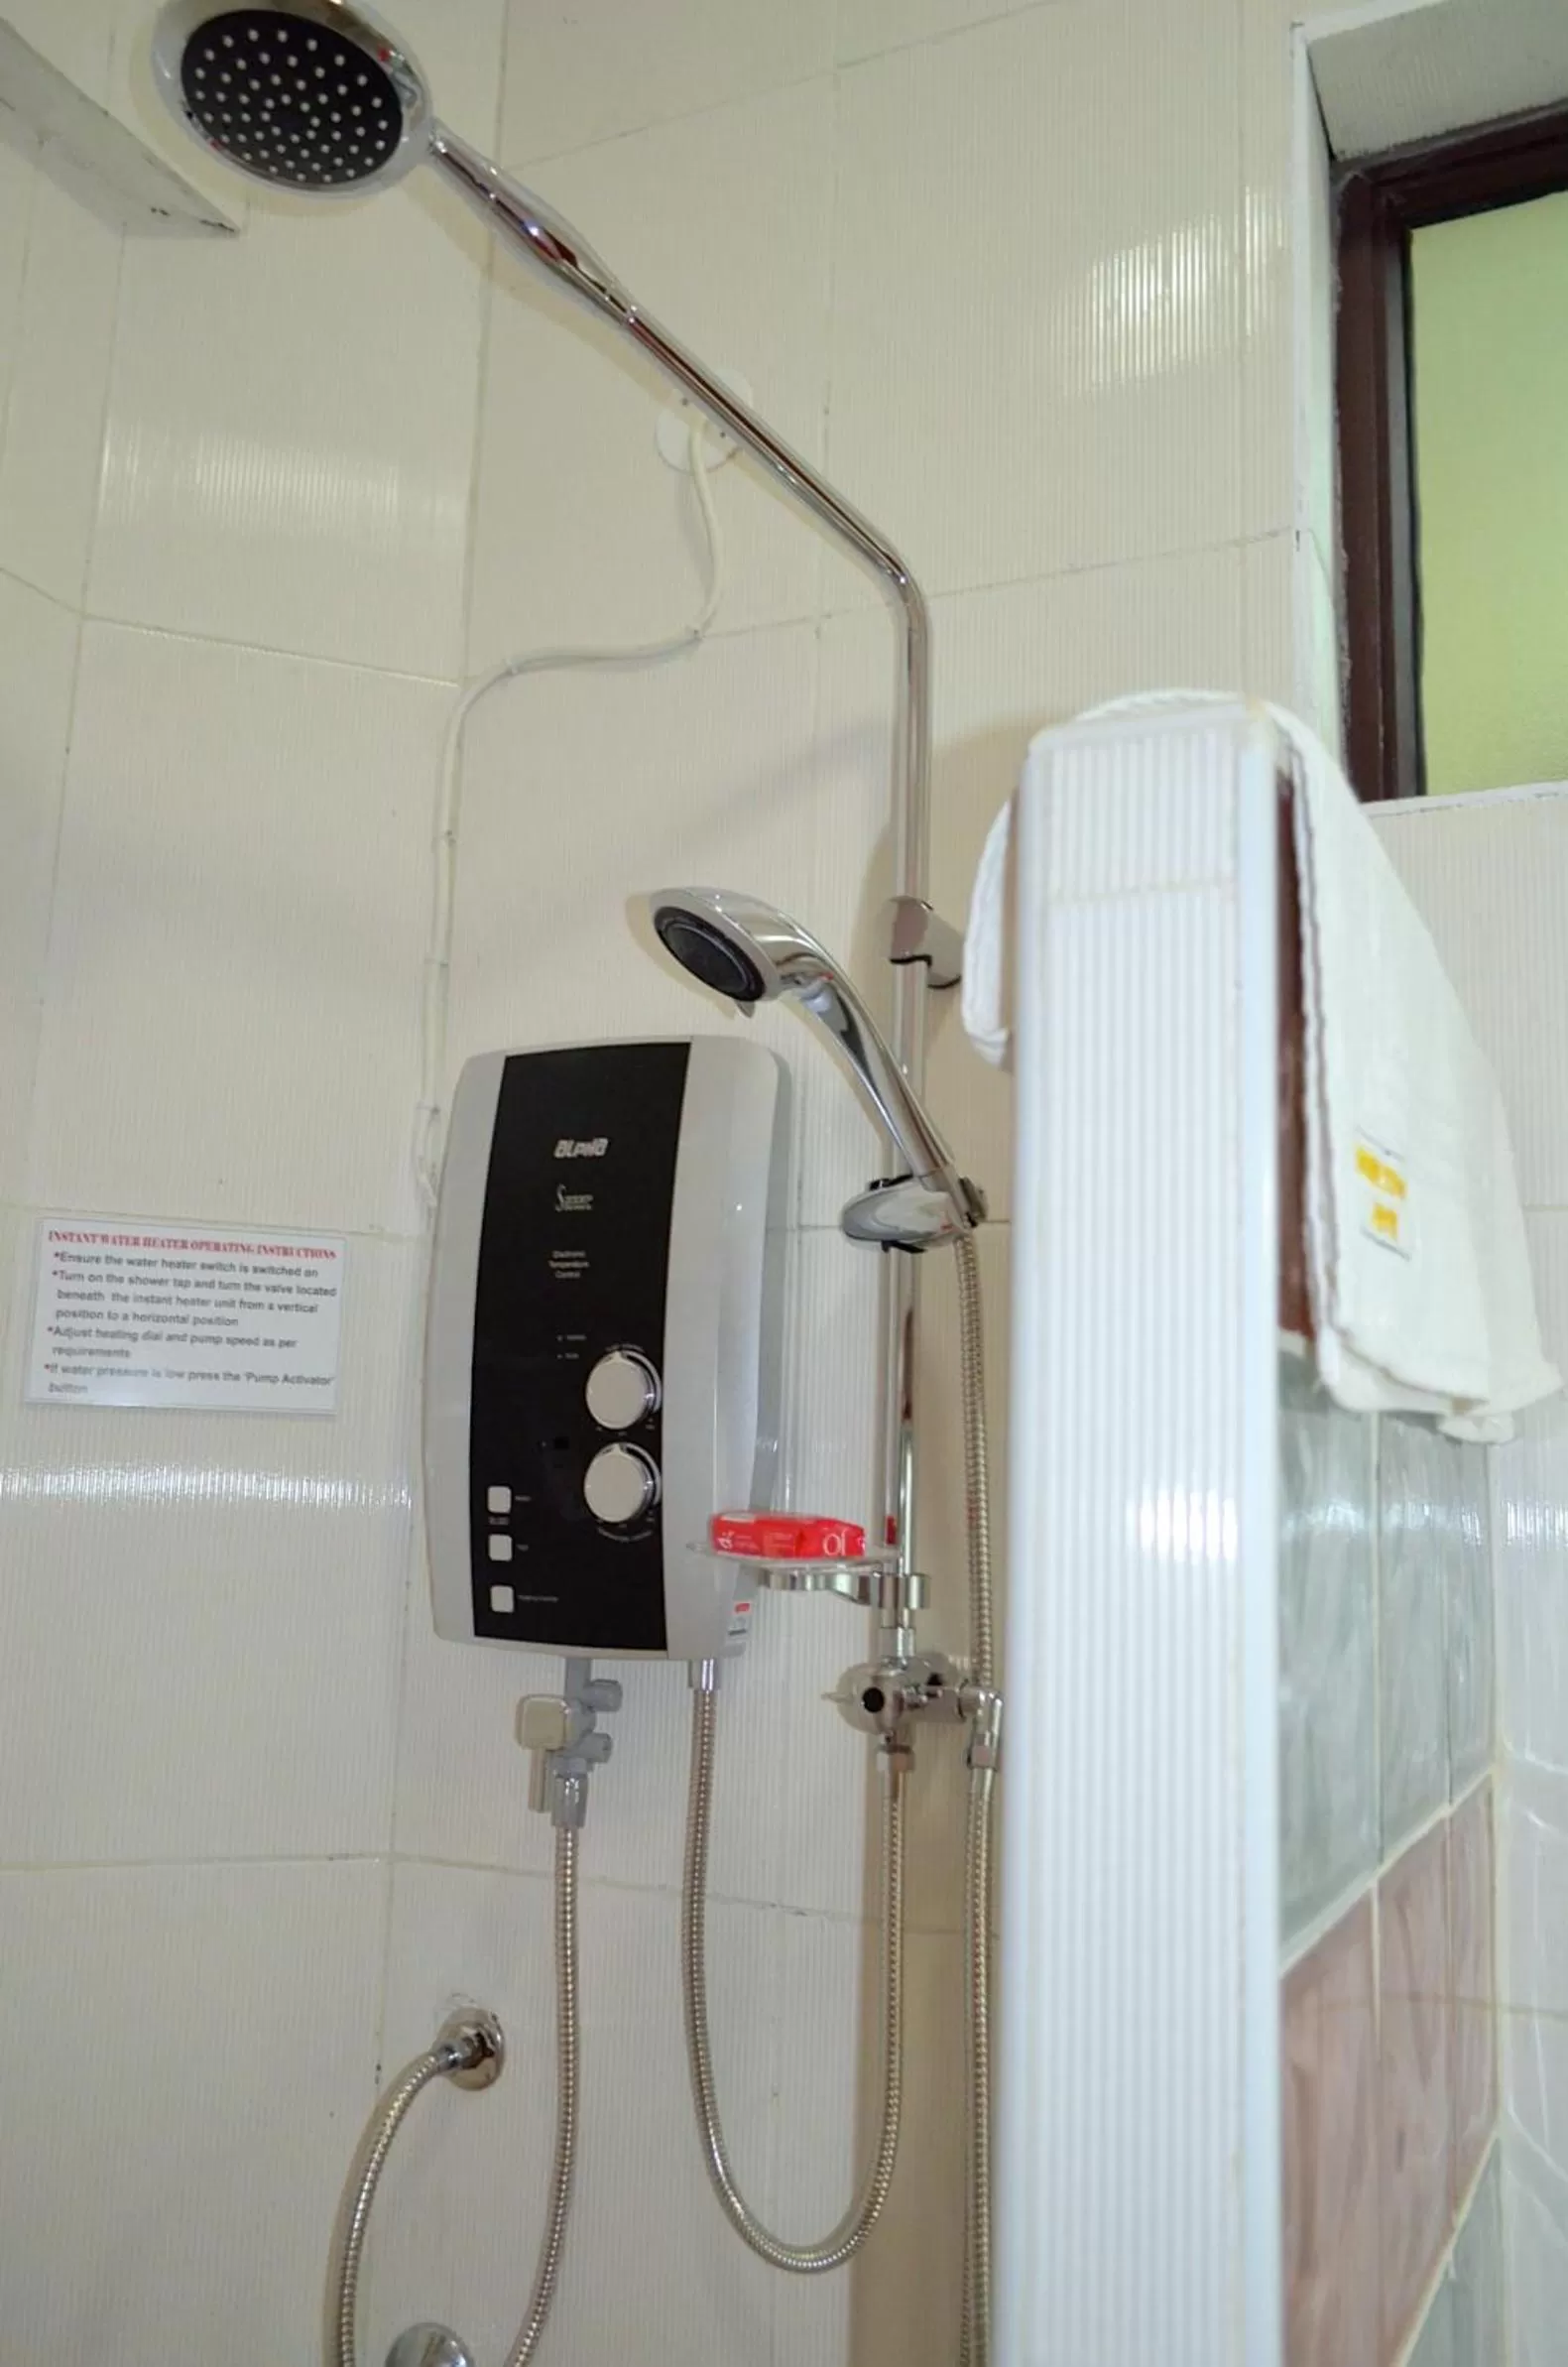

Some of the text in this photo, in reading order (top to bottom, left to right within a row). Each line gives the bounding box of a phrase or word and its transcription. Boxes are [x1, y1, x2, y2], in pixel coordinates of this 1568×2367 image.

[49, 1230, 337, 1259] INSTANT WATER HEATER OPERATING INSTRUCTIONS
[104, 1254, 123, 1265] the
[126, 1257, 158, 1268] water
[161, 1258, 196, 1271] heater
[200, 1260, 236, 1273] switch
[239, 1262, 249, 1274] is
[252, 1265, 302, 1277] switched
[303, 1269, 318, 1278] on
[87, 1274, 103, 1283] on
[105, 1274, 125, 1284] the
[128, 1276, 169, 1287] shower
[173, 1278, 191, 1290] tap
[194, 1279, 215, 1290] and
[218, 1280, 241, 1291] turn
[244, 1282, 261, 1292] the
[265, 1284, 294, 1295] valve
[296, 1285, 337, 1297] located
[57, 1290, 105, 1302] beneath
[111, 1293, 130, 1304] the
[133, 1295, 173, 1306] instant
[176, 1297, 211, 1308] heater
[213, 1298, 236, 1308] unit
[239, 1300, 264, 1310] from
[277, 1303, 318, 1313] vertical
[56, 1308, 103, 1321] position
[107, 1310, 120, 1320] to
[133, 1312, 189, 1324] horizontal
[192, 1315, 238, 1327] position
[54, 1325, 297, 1350] Adjust heating dial and pump speed as per
[52, 1346, 131, 1359] requirements
[61, 1365, 93, 1376] water
[96, 1367, 149, 1379] pressure
[151, 1369, 161, 1379] is
[164, 1368, 185, 1380] low
[188, 1371, 220, 1383] press
[222, 1371, 241, 1382] the
[48, 1381, 89, 1394] button
